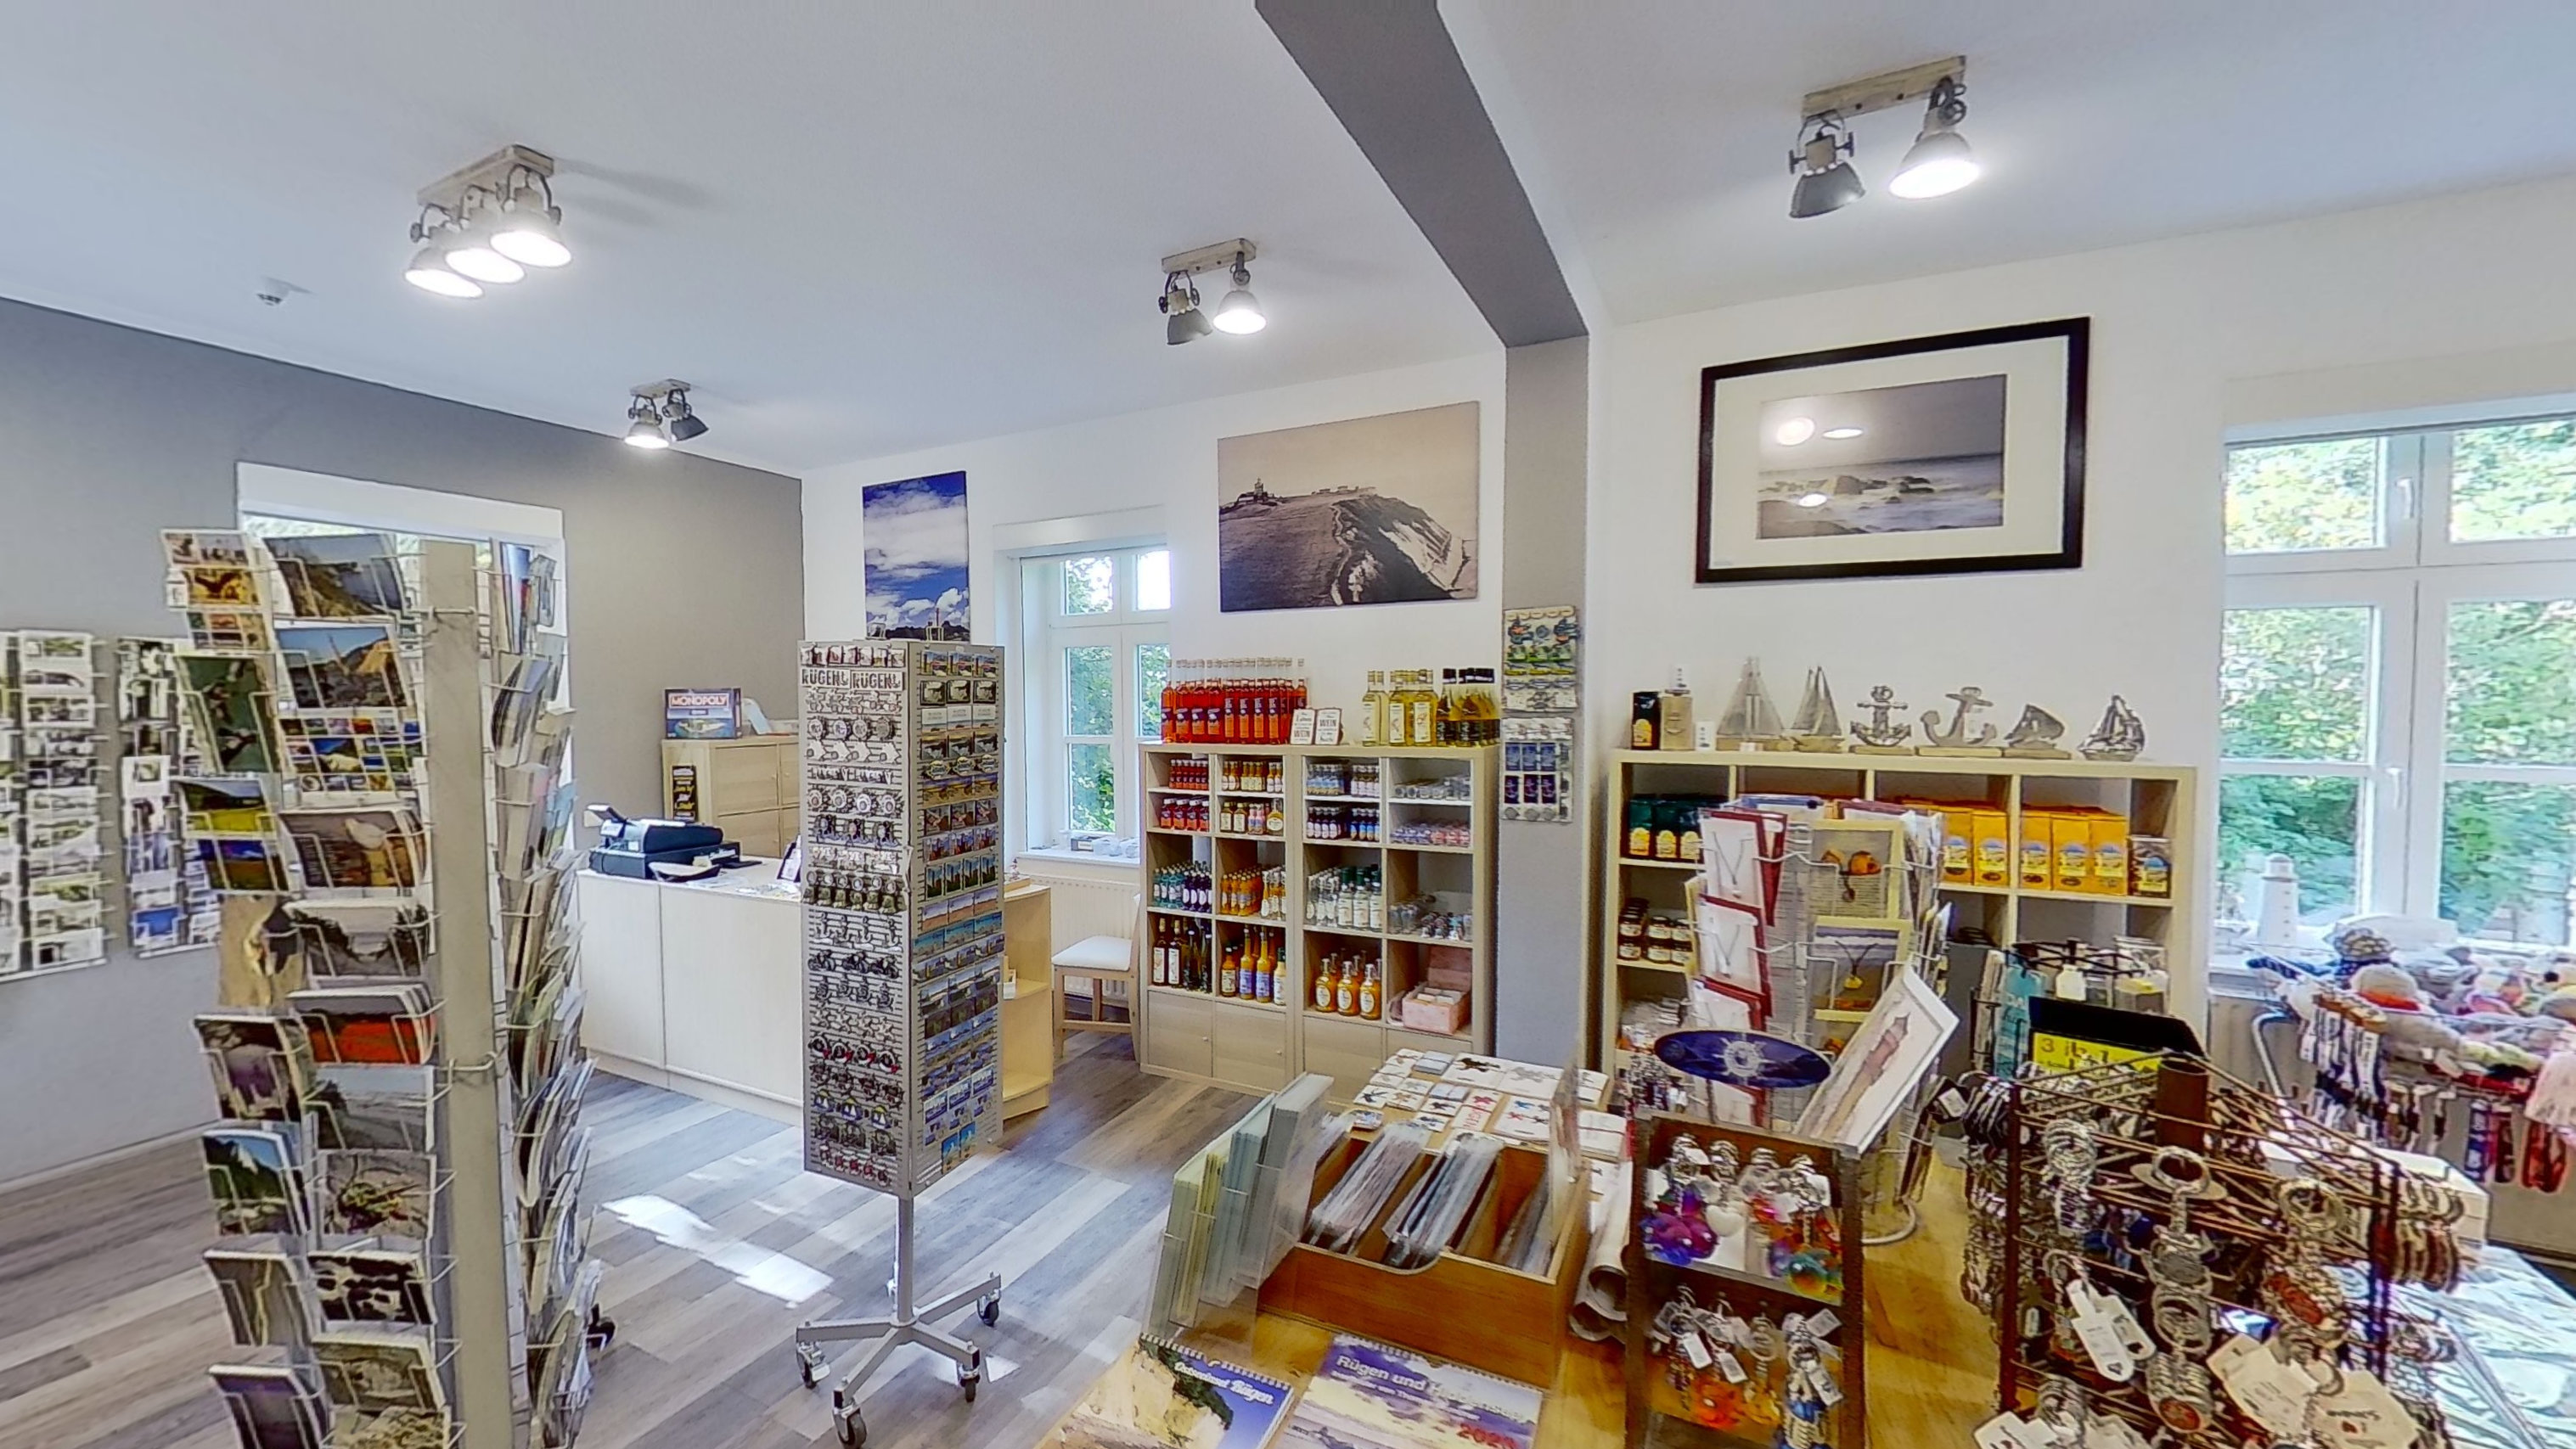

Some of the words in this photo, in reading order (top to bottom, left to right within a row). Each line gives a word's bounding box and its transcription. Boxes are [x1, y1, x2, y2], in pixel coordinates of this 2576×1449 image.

[671, 696, 728, 706] MONOPOLY
[1336, 1356, 1390, 1379] Rügen
[1392, 1373, 1427, 1390] und
